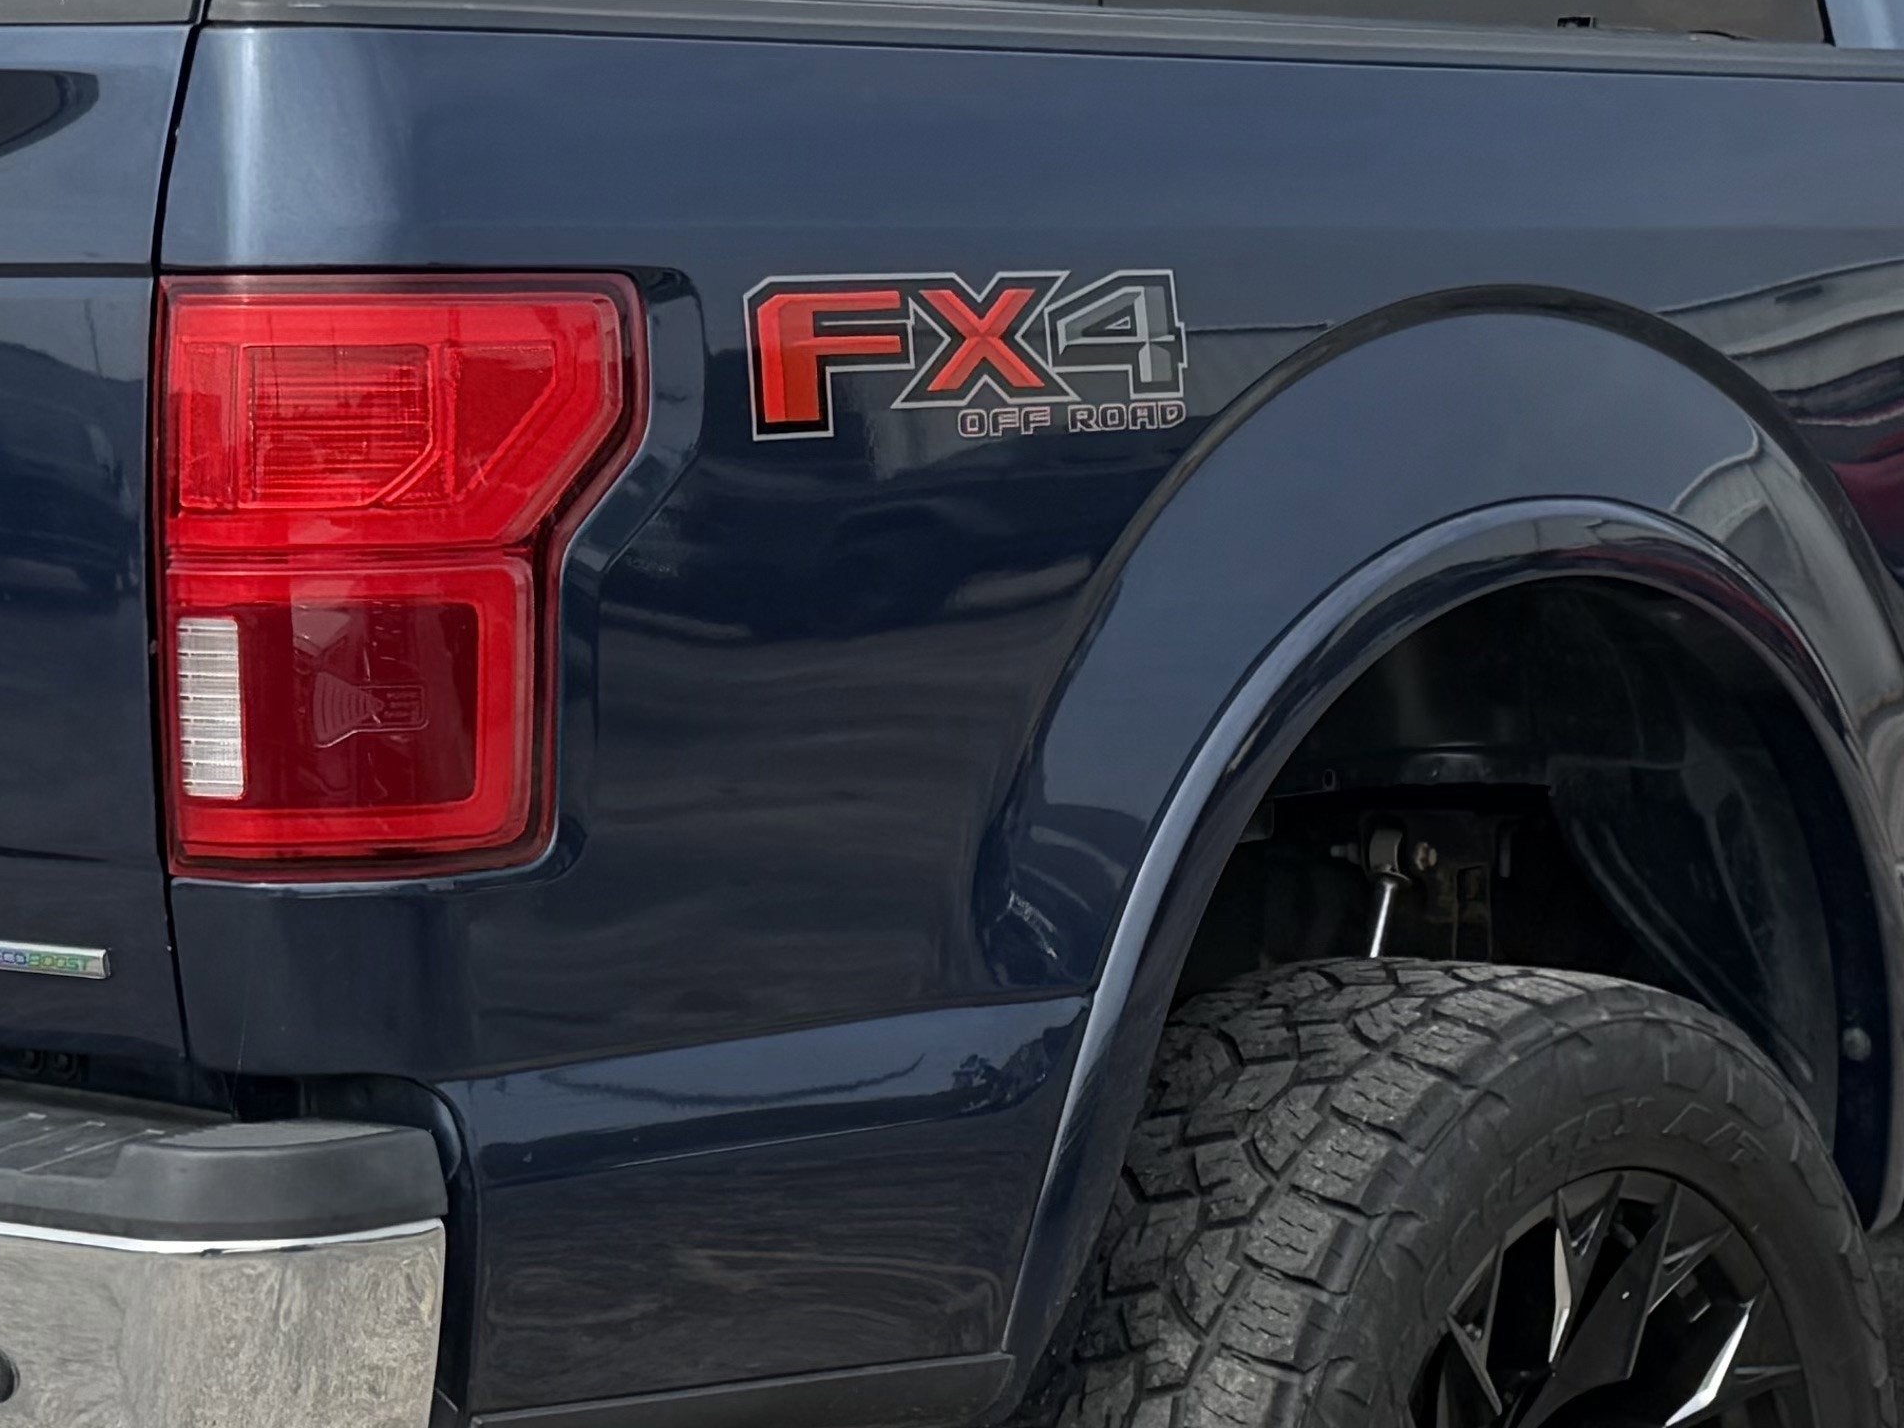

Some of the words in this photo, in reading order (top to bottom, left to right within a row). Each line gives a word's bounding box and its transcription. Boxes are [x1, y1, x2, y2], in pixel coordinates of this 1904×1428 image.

[742, 269, 1188, 441] FX4
[957, 406, 1051, 438] OFF
[1067, 400, 1187, 433] ROAD
